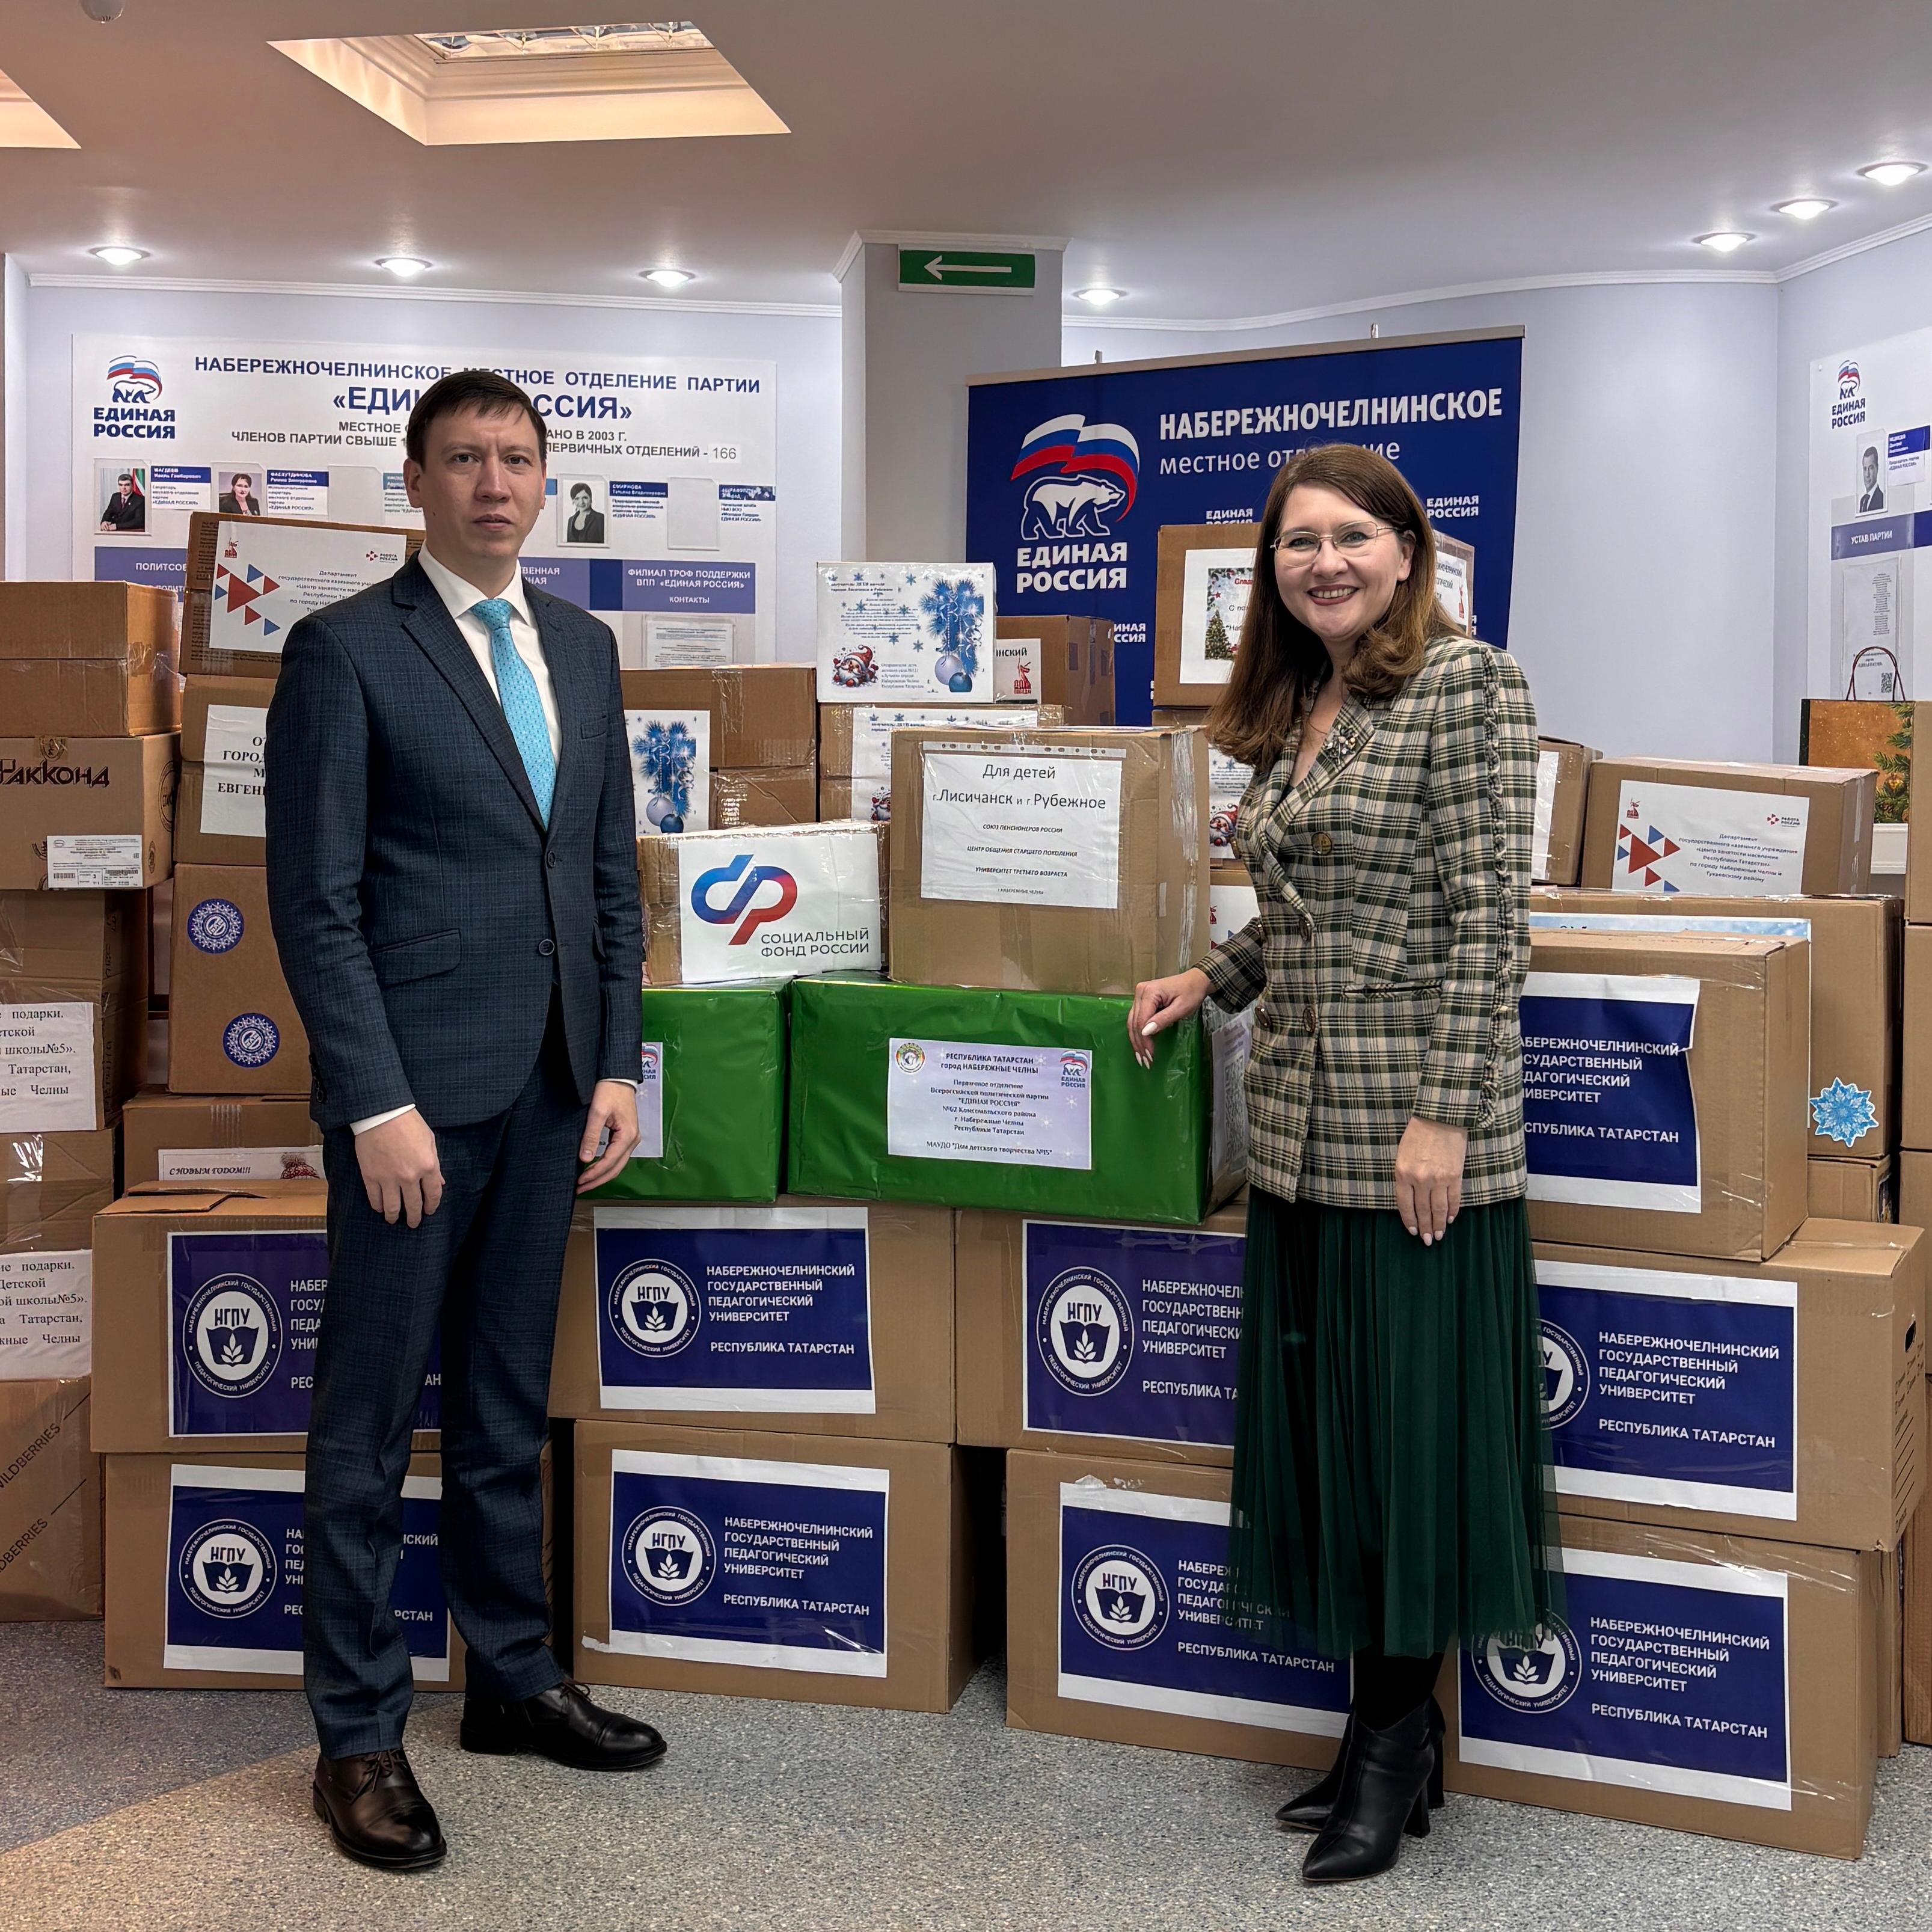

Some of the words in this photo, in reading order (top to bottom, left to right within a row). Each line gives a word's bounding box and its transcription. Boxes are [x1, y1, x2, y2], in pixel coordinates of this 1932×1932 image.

[195, 355, 452, 381] НАБЕРЕЖНОЧЕЛНИНСКОЕ
[565, 372, 676, 390] ОТДЕЛЕНИЕ
[687, 376, 760, 393] ПАРТИИ
[533, 394, 631, 419] ССИЯ»
[1160, 387, 1502, 440] НАБЕРЕЖНОЧЕЛНИНСКОЕ
[1832, 397, 1865, 416] ЕДИНАЯ
[93, 408, 175, 423] ЕДИНАЯ
[1832, 411, 1865, 429] РОССИЯ
[93, 424, 175, 439] РОССИЯ
[339, 421, 401, 434] МЕСТНОЕ
[577, 431, 584, 440] В
[588, 431, 615, 441] 2003
[618, 432, 627, 441] Г.
[232, 432, 286, 443] ЧЛЕНОВ
[290, 434, 342, 445] ПАРТИИ
[346, 435, 397, 446] СВЫШЕ
[626, 445, 700, 458] ОТДЕЛЕНИЙ
[713, 447, 737, 459] 166
[1160, 450, 1258, 476] местное
[1427, 495, 1479, 508] ЕДИНАЯ
[1206, 508, 1253, 520] ЕДИНАЯ
[1427, 506, 1479, 519] РОССИЯ
[1851, 533, 1869, 544] УСТАВ
[1869, 530, 1892, 542] ПАРТИИ
[1017, 542, 1127, 568] ЕДИНАЯ
[696, 571, 750, 579] ПОДДЕРЖКИ
[1017, 567, 1127, 594] РОССИЯ
[660, 580, 701, 588] «ЕДИНАЯ
[1114, 623, 1146, 633] ИНАЯ
[1114, 633, 1146, 643] ССИЯ
[983, 764, 1010, 779] Для
[1013, 766, 1056, 780] детей
[761, 927, 869, 945] СОЦИАЛЬНЫЙ
[761, 945, 806, 957] ФОНД
[811, 943, 869, 955] РОССИИ
[13, 1010, 64, 1020] подарки.
[5, 1044, 76, 1055] школы№5».
[1520, 1037, 1679, 1056] БЕРЕЖНОЧЕЛНИНСКИЙ
[946, 1053, 992, 1062] РЕСПУБЛИКА
[993, 1056, 1034, 1064] ТАТАРСТАН
[1526, 1054, 1643, 1071] СУДАРСТВЕННЫЙ
[8, 1064, 71, 1076] Татарстан,
[963, 1064, 1011, 1073] НАБЕРЕЖНЫЕ
[1523, 1072, 1630, 1088] ДАГОГИЧЕСКИЙ
[31, 1085, 69, 1095] Челны
[1523, 1088, 1601, 1103] ИВЕРСИТЕТ
[1524, 1122, 1595, 1138] СПУБЛИКА
[1598, 1127, 1679, 1143] ТАТАРСТАН
[22, 1262, 75, 1272] подарки.
[707, 1264, 855, 1276] НАБЕРЕЖНОЧЕЛНИНСКИЙ
[637, 1286, 670, 1301] НГПУ
[707, 1279, 822, 1292] ГОСУДАРСТВЕННЫЙ
[1142, 1280, 1244, 1299] НАБЕРЕЖНОЧЕЛ
[16, 1294, 87, 1305] школы№5».
[708, 1295, 813, 1308] ПЕДАГОГИЧЕСКИЙ
[214, 1308, 250, 1327] НГПУ
[709, 1311, 789, 1322] УНИВЕРСИТЕТ
[1067, 1302, 1102, 1322] НГПУ
[1142, 1299, 1244, 1319] ГОСУДАРСТВЕНН
[43, 1334, 81, 1343] Челны
[1142, 1320, 1242, 1340] ПЕДАГОГИЧЕСКИ
[711, 1342, 784, 1353] РЕСПУБЛИКА
[788, 1343, 854, 1354] ТАТАРСТАН
[1142, 1340, 1227, 1359] УНИВЕРСИТЕТ
[1599, 1331, 1780, 1360] НАБЕРЕЖНОЧЕЛНИНСКИЙ
[1599, 1349, 1738, 1374] ГОСУДАРСТВЕННЫЙ
[1599, 1366, 1726, 1390] ПЕДАГОГИЧЕСКИЙ
[1142, 1381, 1221, 1399] РЕСПУБЛИКА
[1599, 1384, 1696, 1405] УНИВЕРСИТЕТ
[1599, 1418, 1689, 1440] РЕСПУБЛИКА
[1692, 1429, 1775, 1449] ТАТАРСТАН
[725, 1517, 873, 1539] НАБЕРЕЖНОЧЕЛНИНСКИЙ
[0, 1518, 48, 1573] DBERRIES
[652, 1533, 685, 1548] НГПУ
[725, 1532, 839, 1551] ГОСУДАРСТВЕННЫЙ
[210, 1547, 246, 1562] НГПУ
[724, 1548, 829, 1566] ПЕДАГОГИЧЕСКИЙ
[724, 1563, 804, 1580] УНИВЕРСИТЕТ
[1102, 1572, 1138, 1591] НГПУ
[723, 1594, 799, 1610] РЕСПУБЛИКА
[802, 1600, 869, 1616] ТАТАРСТАН
[1590, 1617, 1770, 1651] НАБЕРЕЖНОЧЕЛНИНСКИЙ
[1590, 1634, 1729, 1663] ГОСУДАРСТВЕННЫЙ
[1178, 1642, 1258, 1662] РЕСПУБЛИКА
[1262, 1652, 1334, 1673] ТАТАРСТАН
[1590, 1651, 1717, 1679] ПЕДАГОГИЧЕСКИЙ
[1591, 1669, 1687, 1692] УНИВЕРСИТЕТ
[1592, 1703, 1681, 1727] РЕСПУБЛИКА
[1684, 1716, 1768, 1738] ТАТАРСТАН
